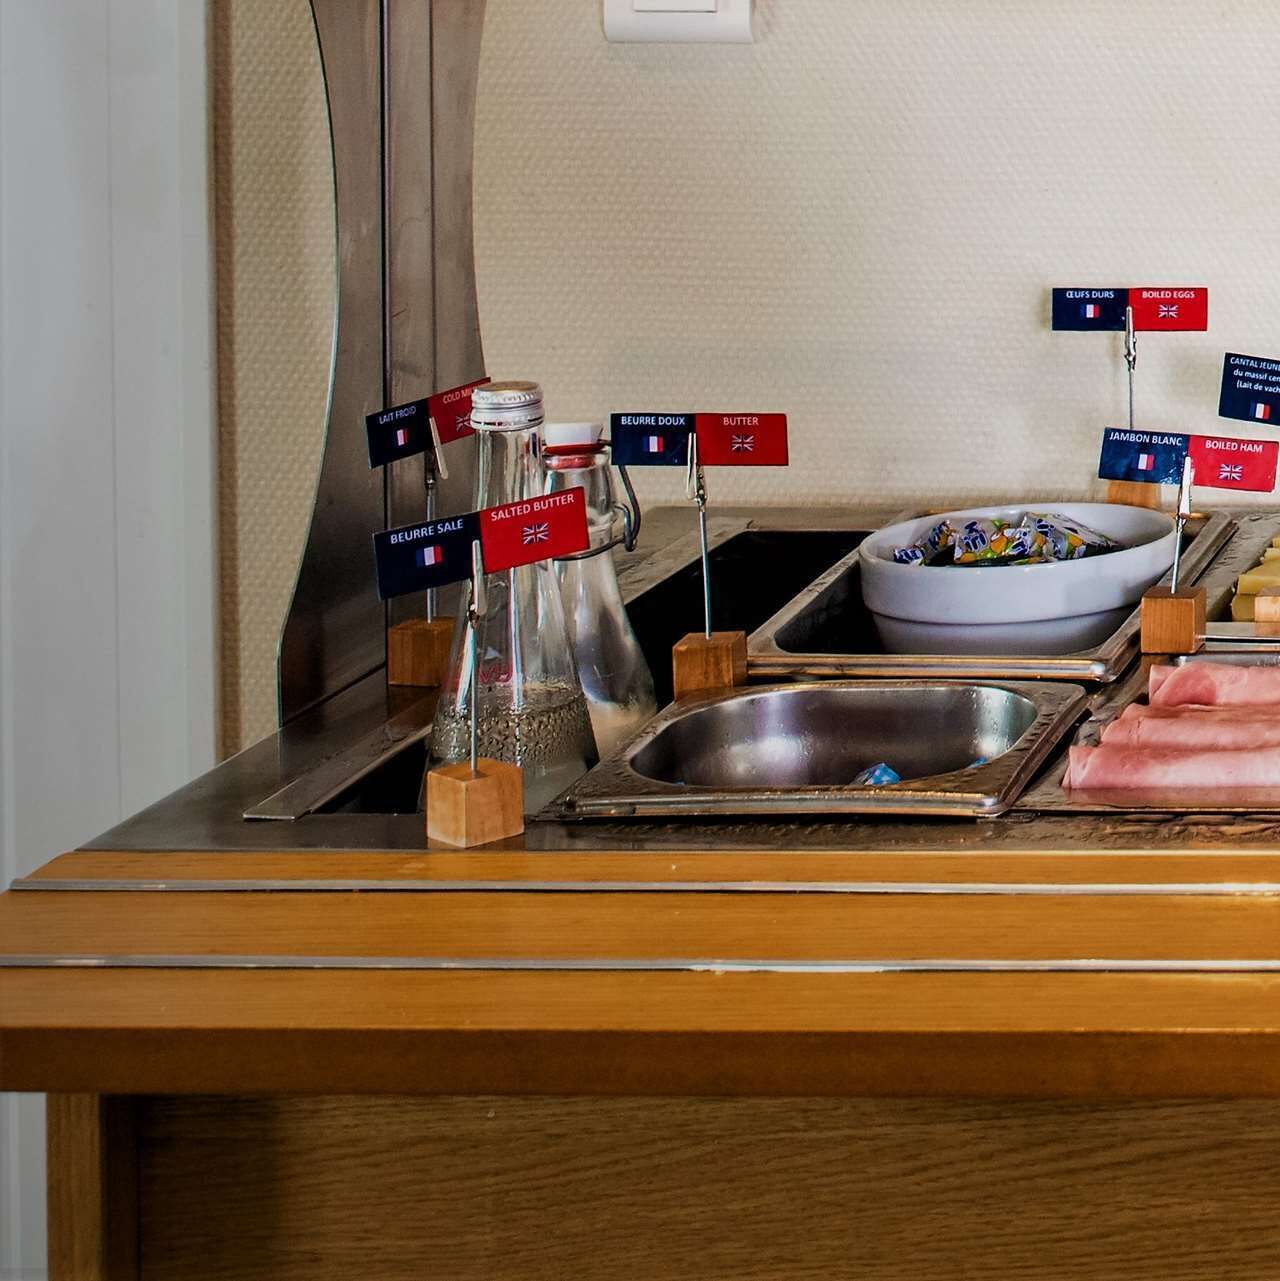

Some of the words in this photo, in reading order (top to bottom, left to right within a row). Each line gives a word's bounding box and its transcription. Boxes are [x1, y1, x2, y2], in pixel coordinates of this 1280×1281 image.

[1091, 291, 1115, 299] DURS
[1142, 291, 1171, 299] BOILED
[1173, 291, 1196, 299] EGGS
[1230, 356, 1259, 369] CANTAL
[1233, 369, 1244, 377] du
[1244, 370, 1268, 381] massif
[1236, 380, 1253, 390] (Lait
[1253, 382, 1263, 391] de
[443, 393, 461, 404] COLD
[379, 412, 394, 425] LAIT
[396, 406, 417, 419] FROID
[621, 416, 657, 426] BEURRE
[658, 416, 686, 426] DOUX
[723, 416, 759, 426] BUTTER
[1109, 432, 1150, 443] JAMBON
[1152, 436, 1183, 446] BLANC
[1205, 440, 1238, 451] BOILED
[1239, 443, 1264, 453] HAM
[491, 503, 531, 522] SALTED
[533, 493, 575, 512] BUTTER
[390, 525, 435, 544] BEURRE
[437, 519, 464, 534] SALE
